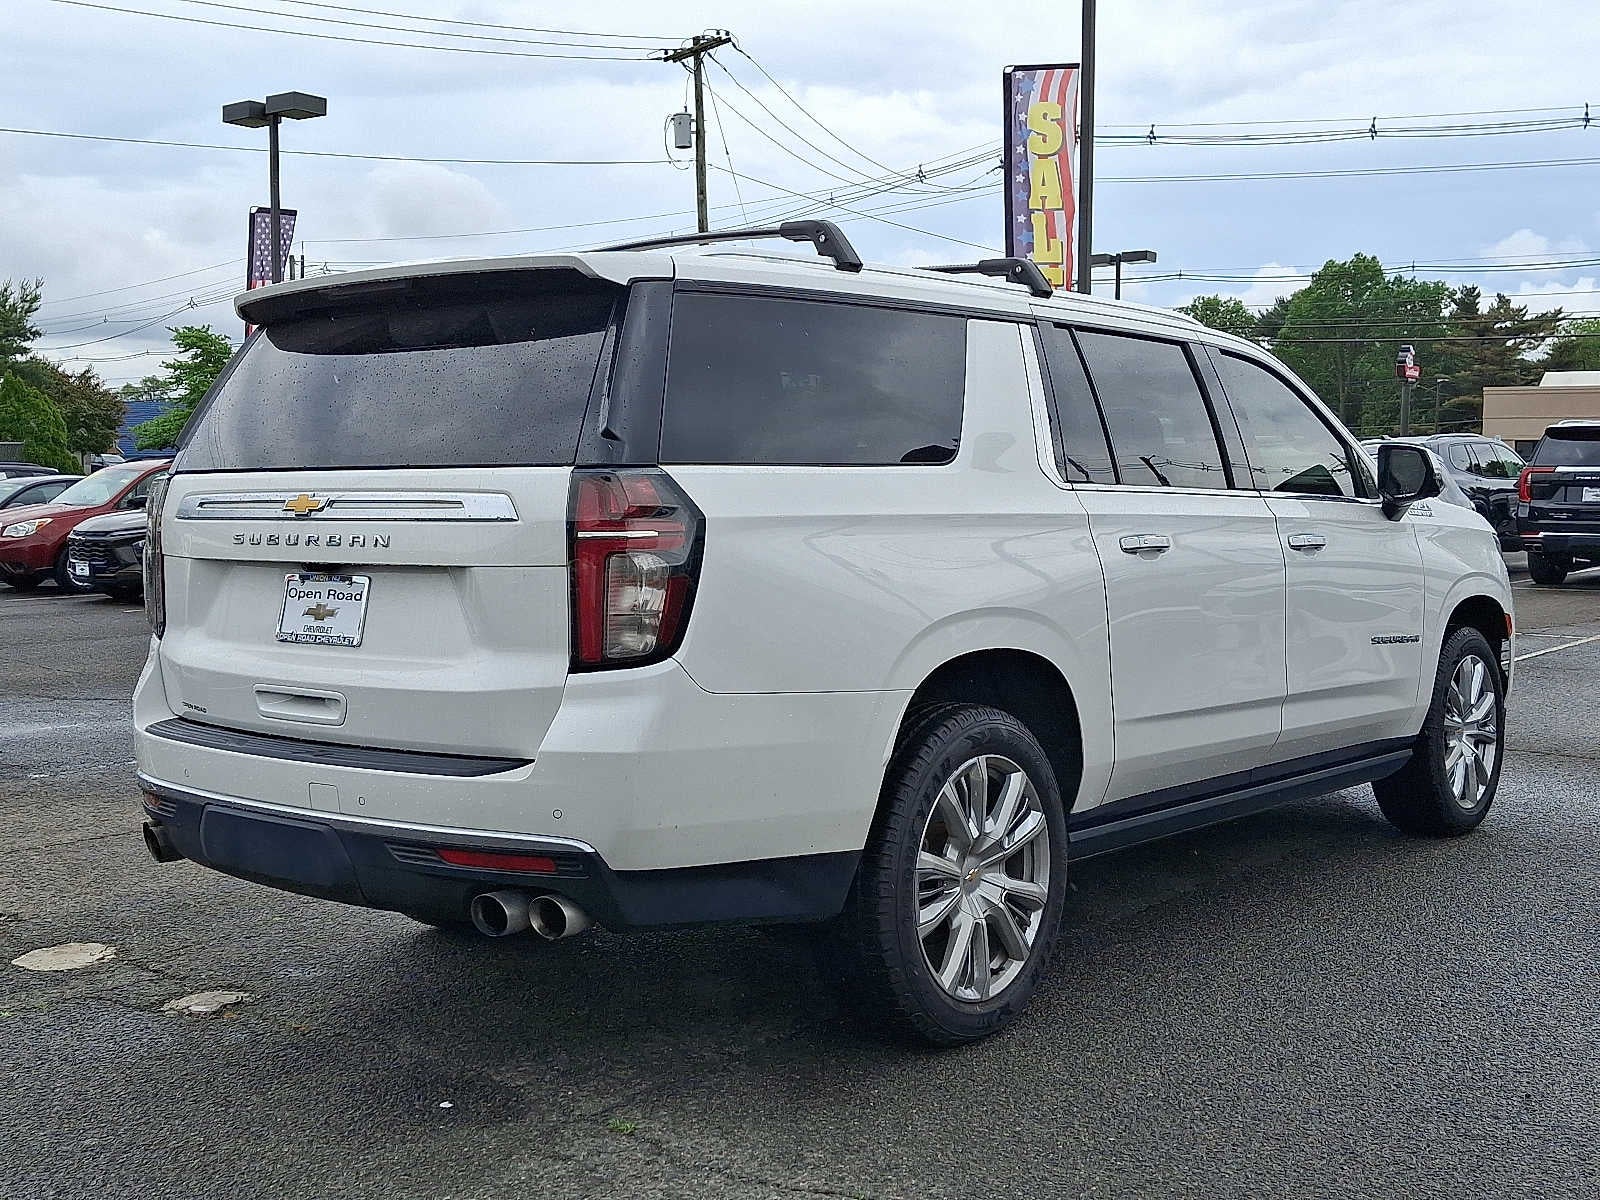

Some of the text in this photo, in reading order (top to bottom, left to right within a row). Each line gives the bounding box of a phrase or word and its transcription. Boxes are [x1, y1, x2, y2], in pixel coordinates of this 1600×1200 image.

[233, 532, 391, 548] SUBURBAN
[288, 587, 363, 601] Open Road
[279, 632, 297, 641] OPEN
[297, 634, 316, 642] ROAD
